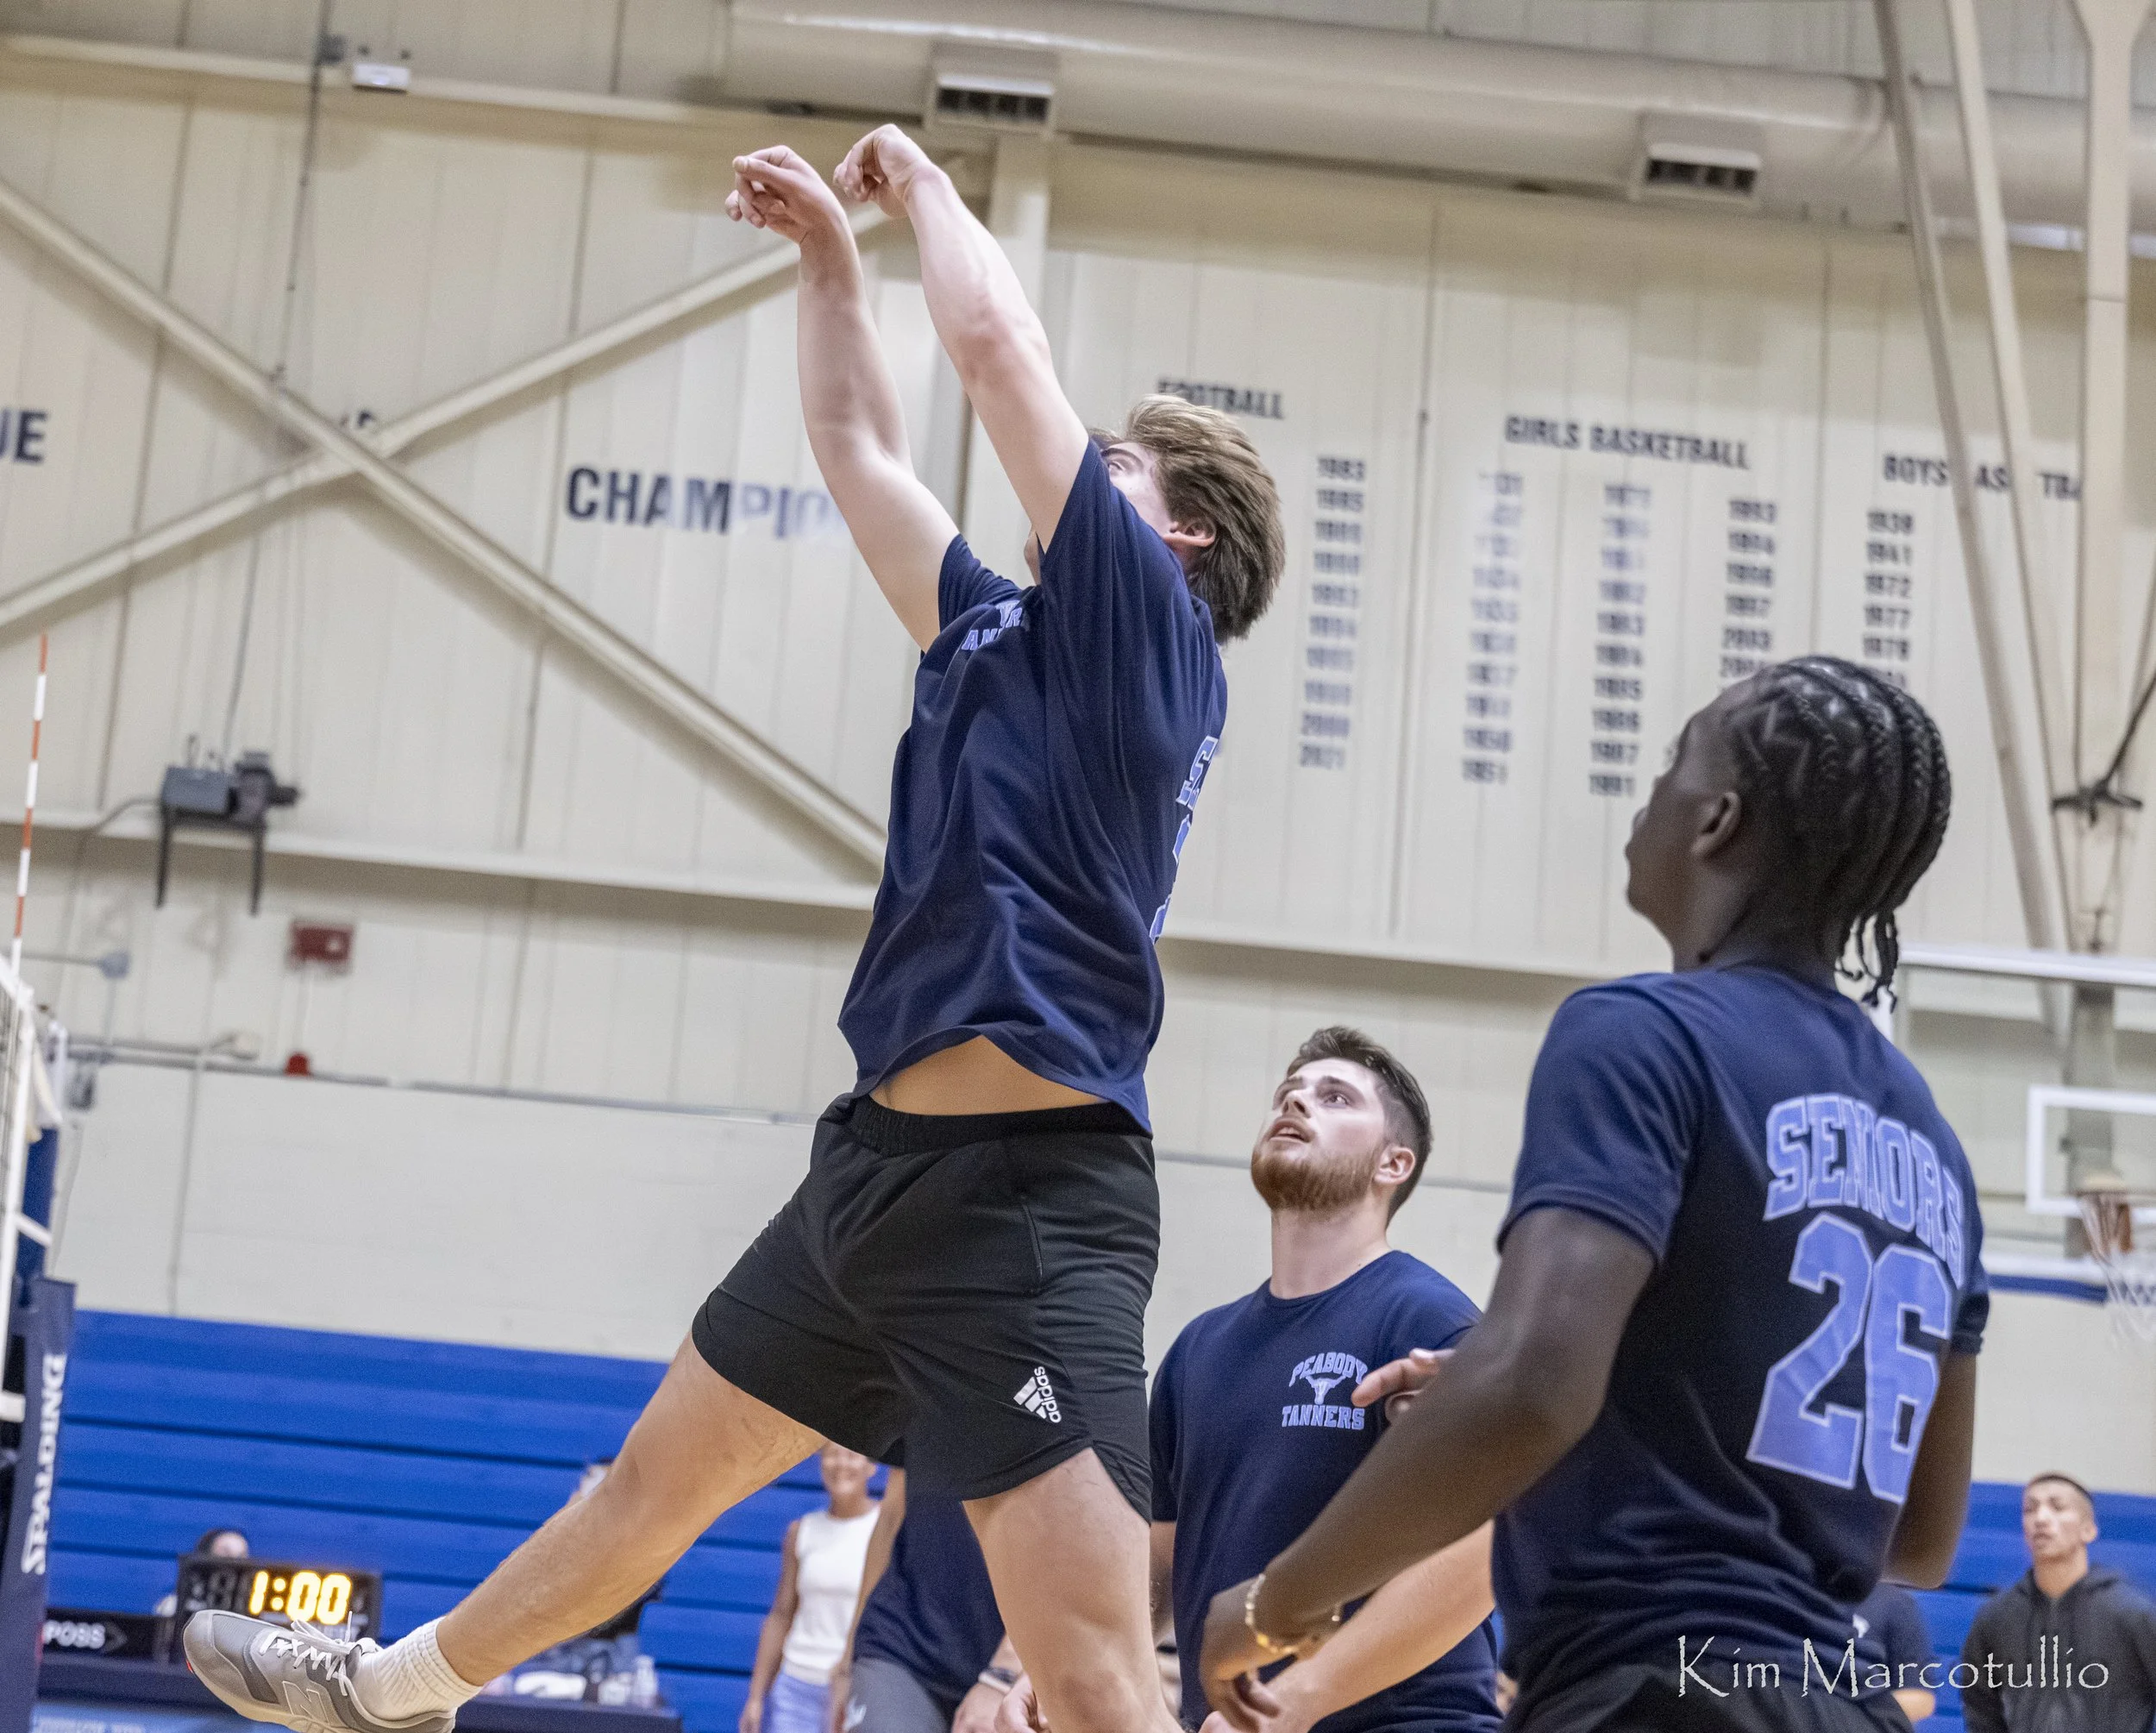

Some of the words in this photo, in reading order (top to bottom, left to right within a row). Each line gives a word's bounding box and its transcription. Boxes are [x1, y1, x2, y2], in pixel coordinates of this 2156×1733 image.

[1505, 416, 1580, 449] GIRLS
[1590, 424, 1750, 469] BASKETBALL
[1884, 455, 1950, 487] BOYS
[566, 468, 838, 540] CHAMPIO
[1288, 1352, 1369, 1387] PEABODY
[1745, 1211, 1952, 1504] 26
[1034, 1366, 1062, 1423] adidas
[1282, 1404, 1365, 1430] TANNERS
[21, 1353, 67, 1575] SPALDING
[248, 1570, 353, 1625] 1:00
[43, 1620, 106, 1649] POSS
